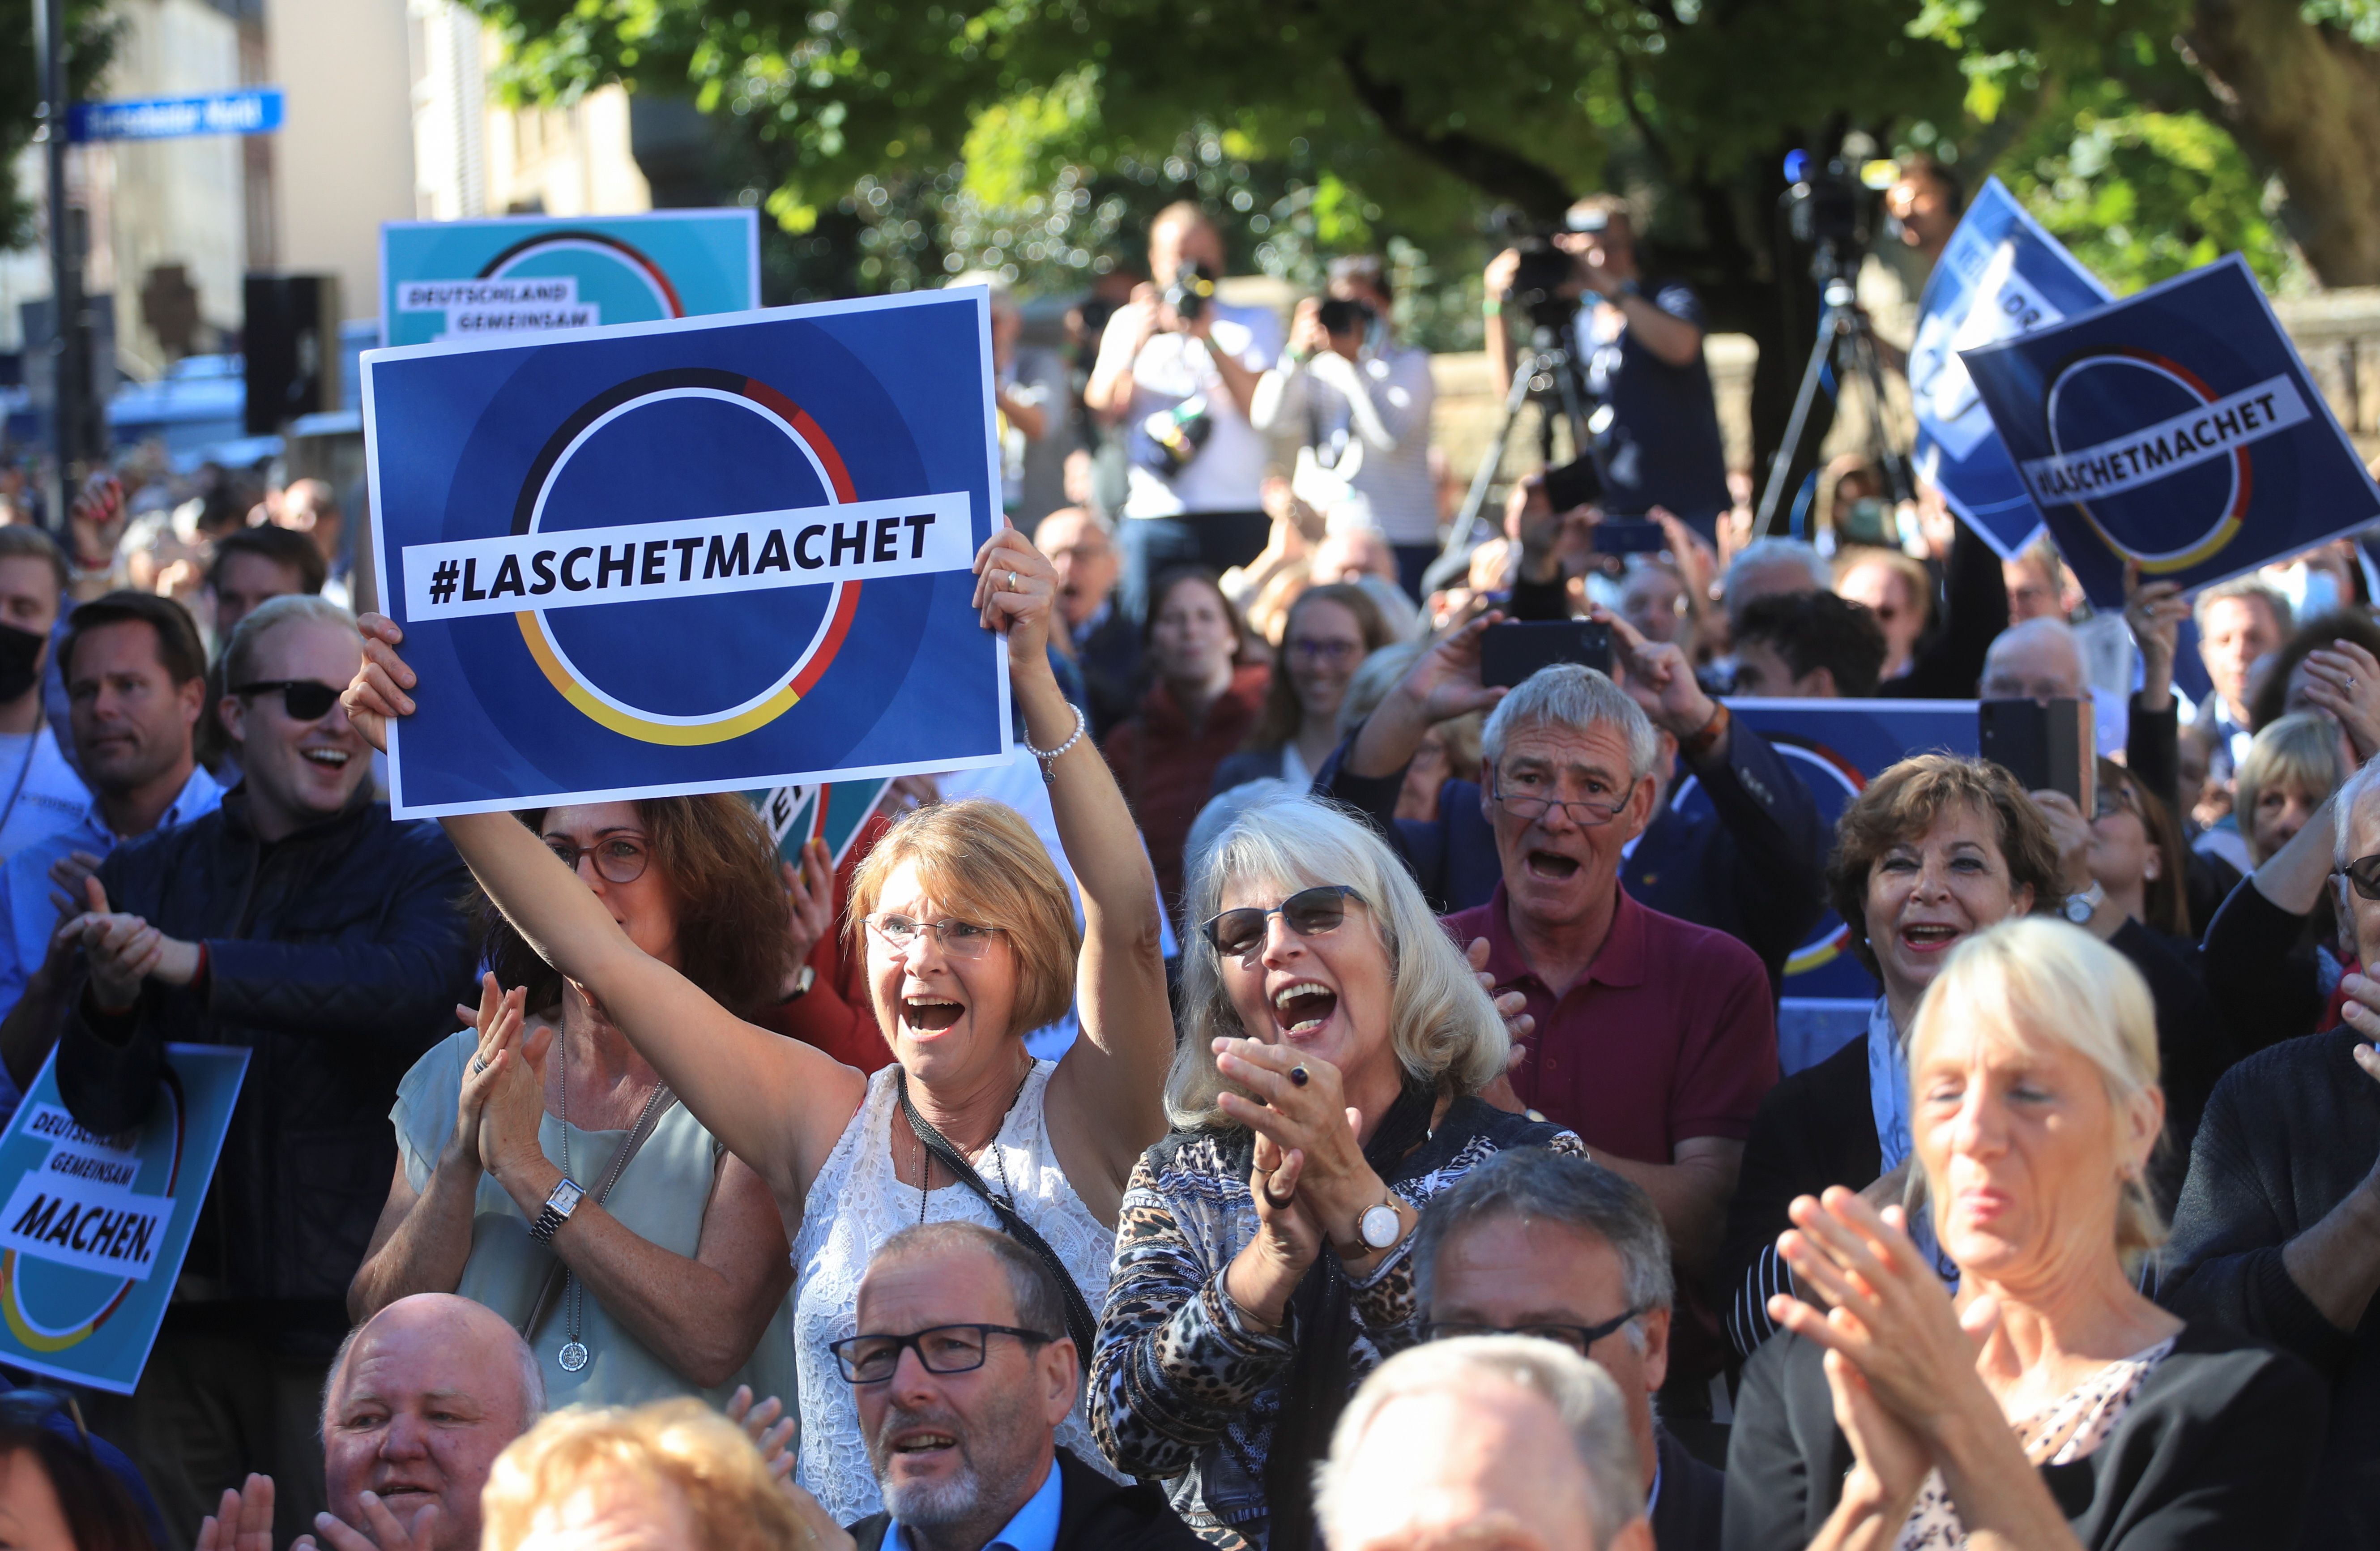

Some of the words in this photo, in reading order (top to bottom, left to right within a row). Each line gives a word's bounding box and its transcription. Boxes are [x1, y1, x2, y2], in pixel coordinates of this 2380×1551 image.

[408, 284, 568, 307] DEUTSCHLAND
[457, 312, 589, 331] GEMEINSAM
[429, 513, 936, 604] #LASCHETMACHET
[51, 1151, 134, 1187] GEMEINSAM
[11, 1192, 157, 1264] MACHEN.
